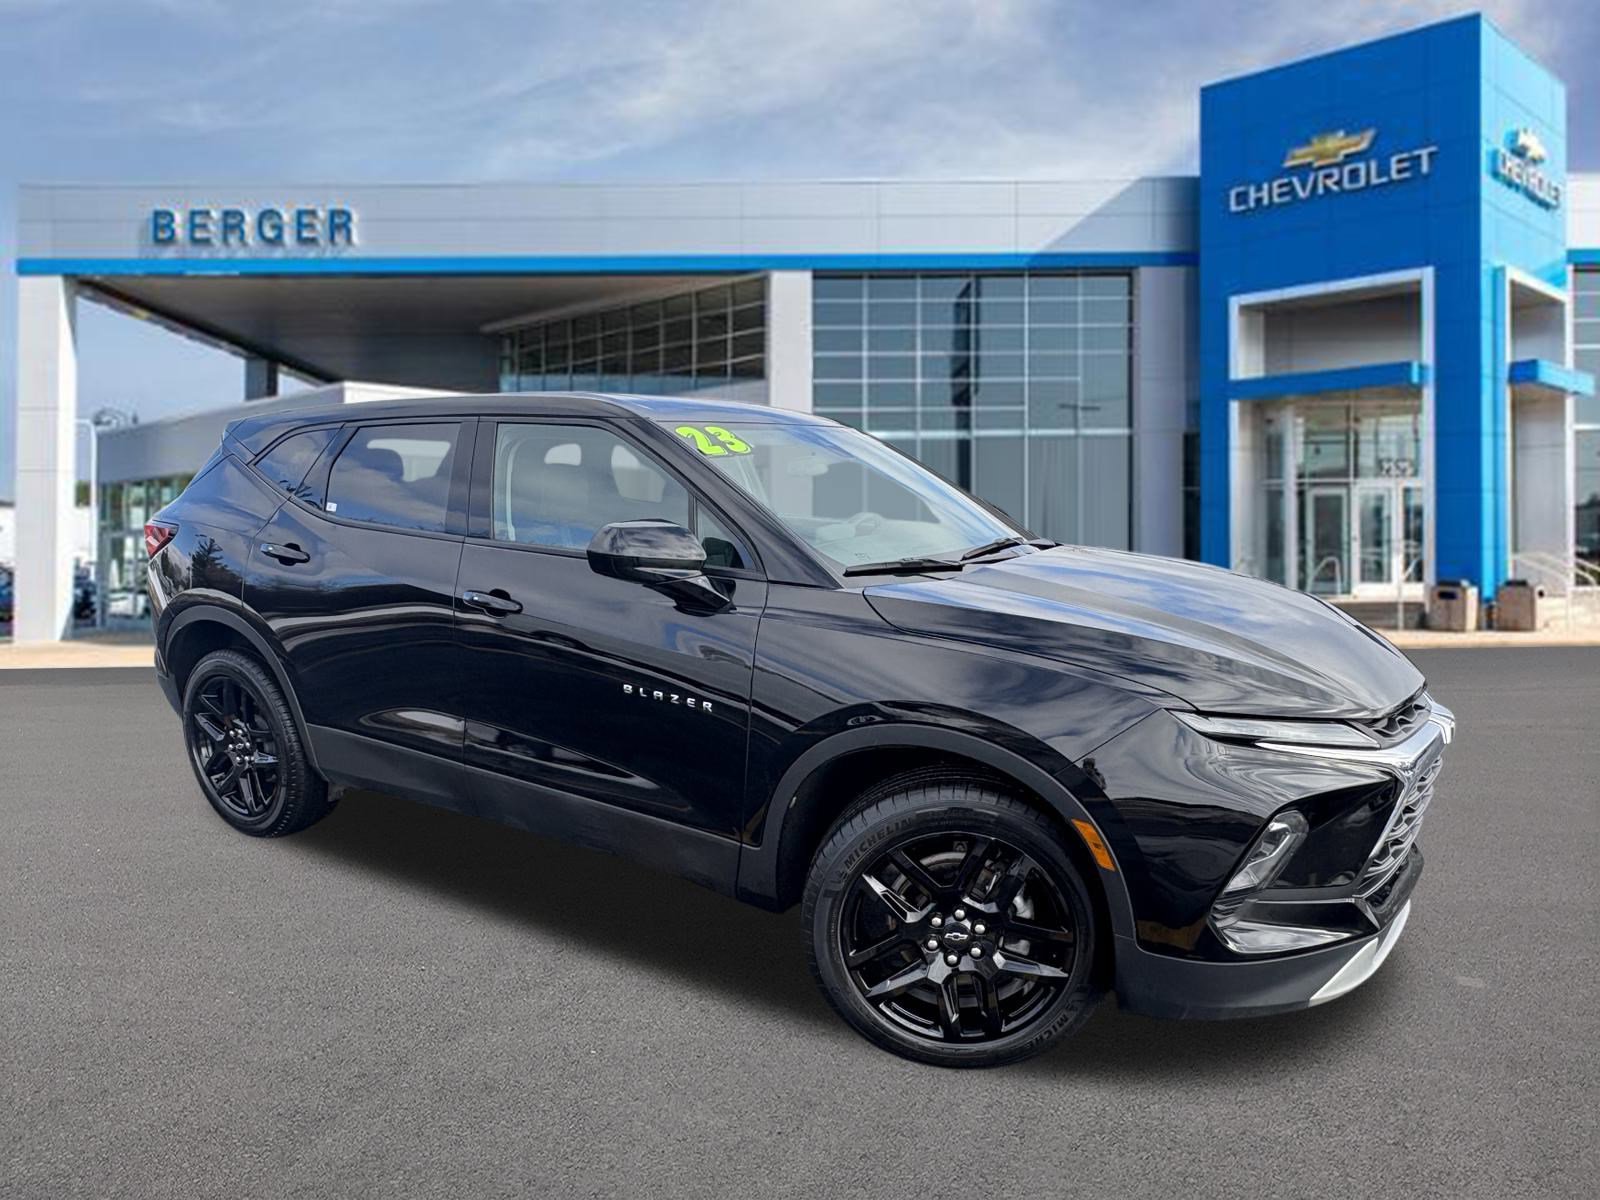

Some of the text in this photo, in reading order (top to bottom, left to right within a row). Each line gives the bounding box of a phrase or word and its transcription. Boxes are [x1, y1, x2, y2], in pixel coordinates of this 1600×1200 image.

[1228, 146, 1438, 212] CHEVROLET
[151, 208, 357, 246] BERGER
[675, 426, 752, 455] 23
[623, 684, 713, 713] BLAZER
[843, 817, 912, 869] MICHELIN
